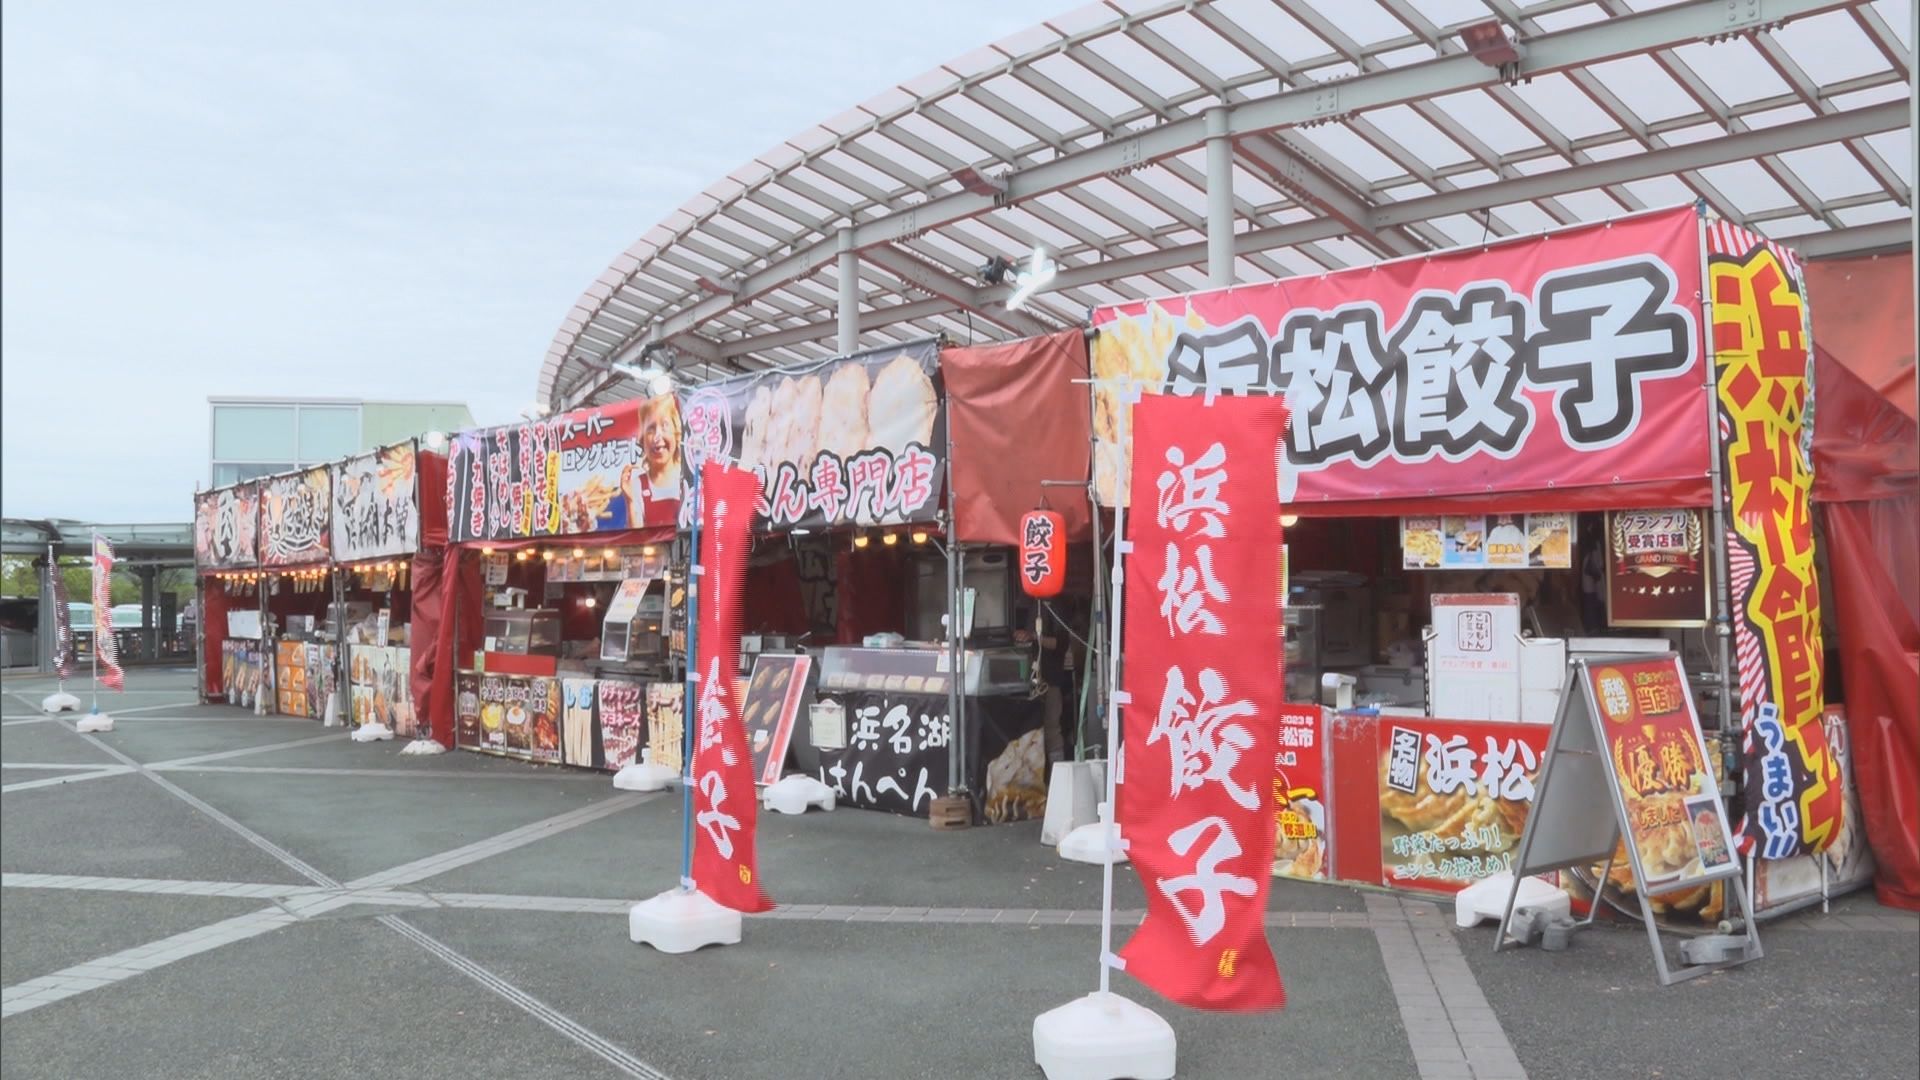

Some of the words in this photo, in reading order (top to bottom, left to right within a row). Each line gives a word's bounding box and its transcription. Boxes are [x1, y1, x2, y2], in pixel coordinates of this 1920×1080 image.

[561, 414, 615, 441] スーパー
[561, 437, 643, 471] ロングポテト
[496, 428, 511, 528] そばめし
[533, 423, 550, 531] やきそば
[1622, 514, 1686, 531] グランプリ
[1628, 533, 1684, 548] 受賞店舗
[1024, 514, 1053, 584] 餃子
[1635, 554, 1661, 564] GRAND
[1476, 613, 1485, 649] こなもん
[565, 684, 592, 710] しお
[601, 686, 640, 702] ケチャップ
[1146, 442, 1262, 948] 浜松餃子
[850, 703, 951, 754] 浜名湖
[1392, 731, 1418, 788] 名物
[1424, 732, 1537, 802] 浜松
[1628, 741, 1693, 794] 優勝
[819, 759, 938, 812] はんぺん
[1392, 853, 1512, 881] ニンニク控えめ!
